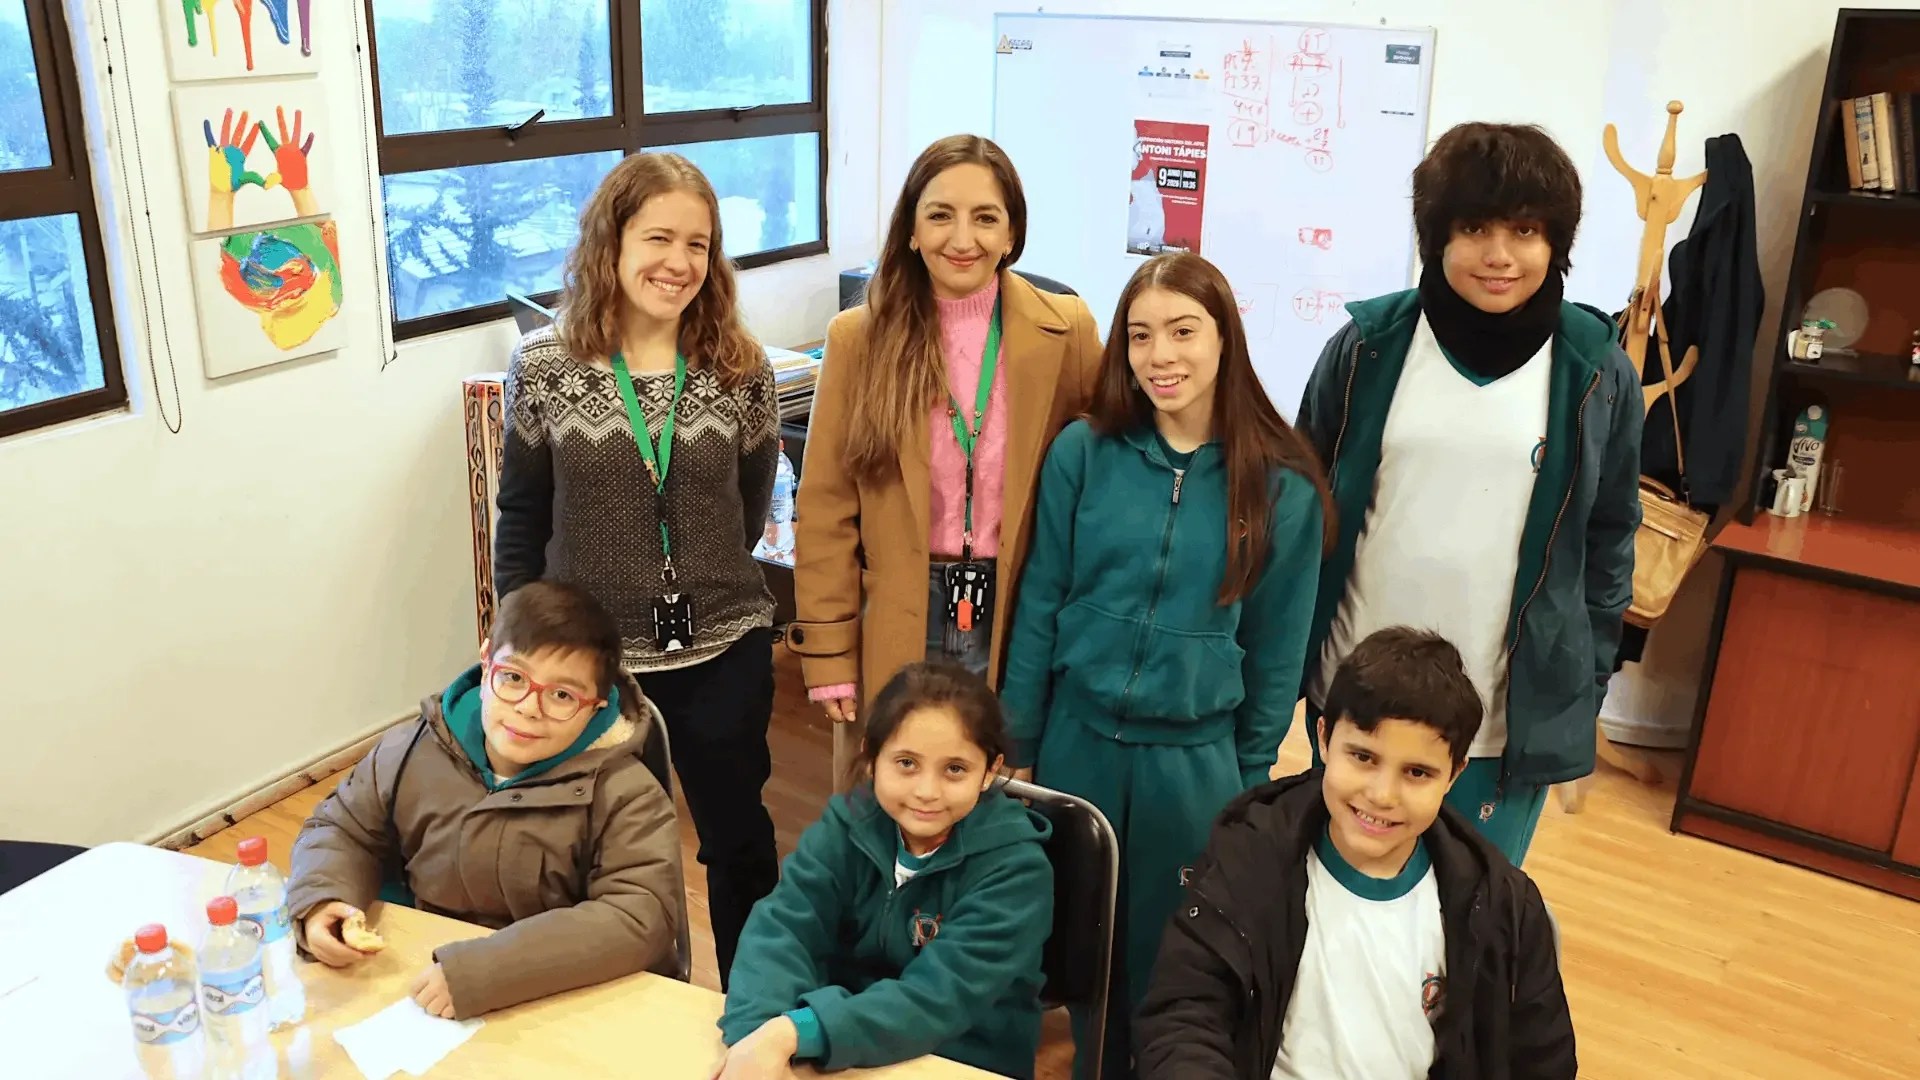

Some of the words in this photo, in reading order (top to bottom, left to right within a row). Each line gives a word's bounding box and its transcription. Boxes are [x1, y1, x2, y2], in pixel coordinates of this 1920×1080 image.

[1136, 144, 1172, 156] ANTONI
[1173, 145, 1207, 159] TÁPIES
[1158, 168, 1167, 186] 9
